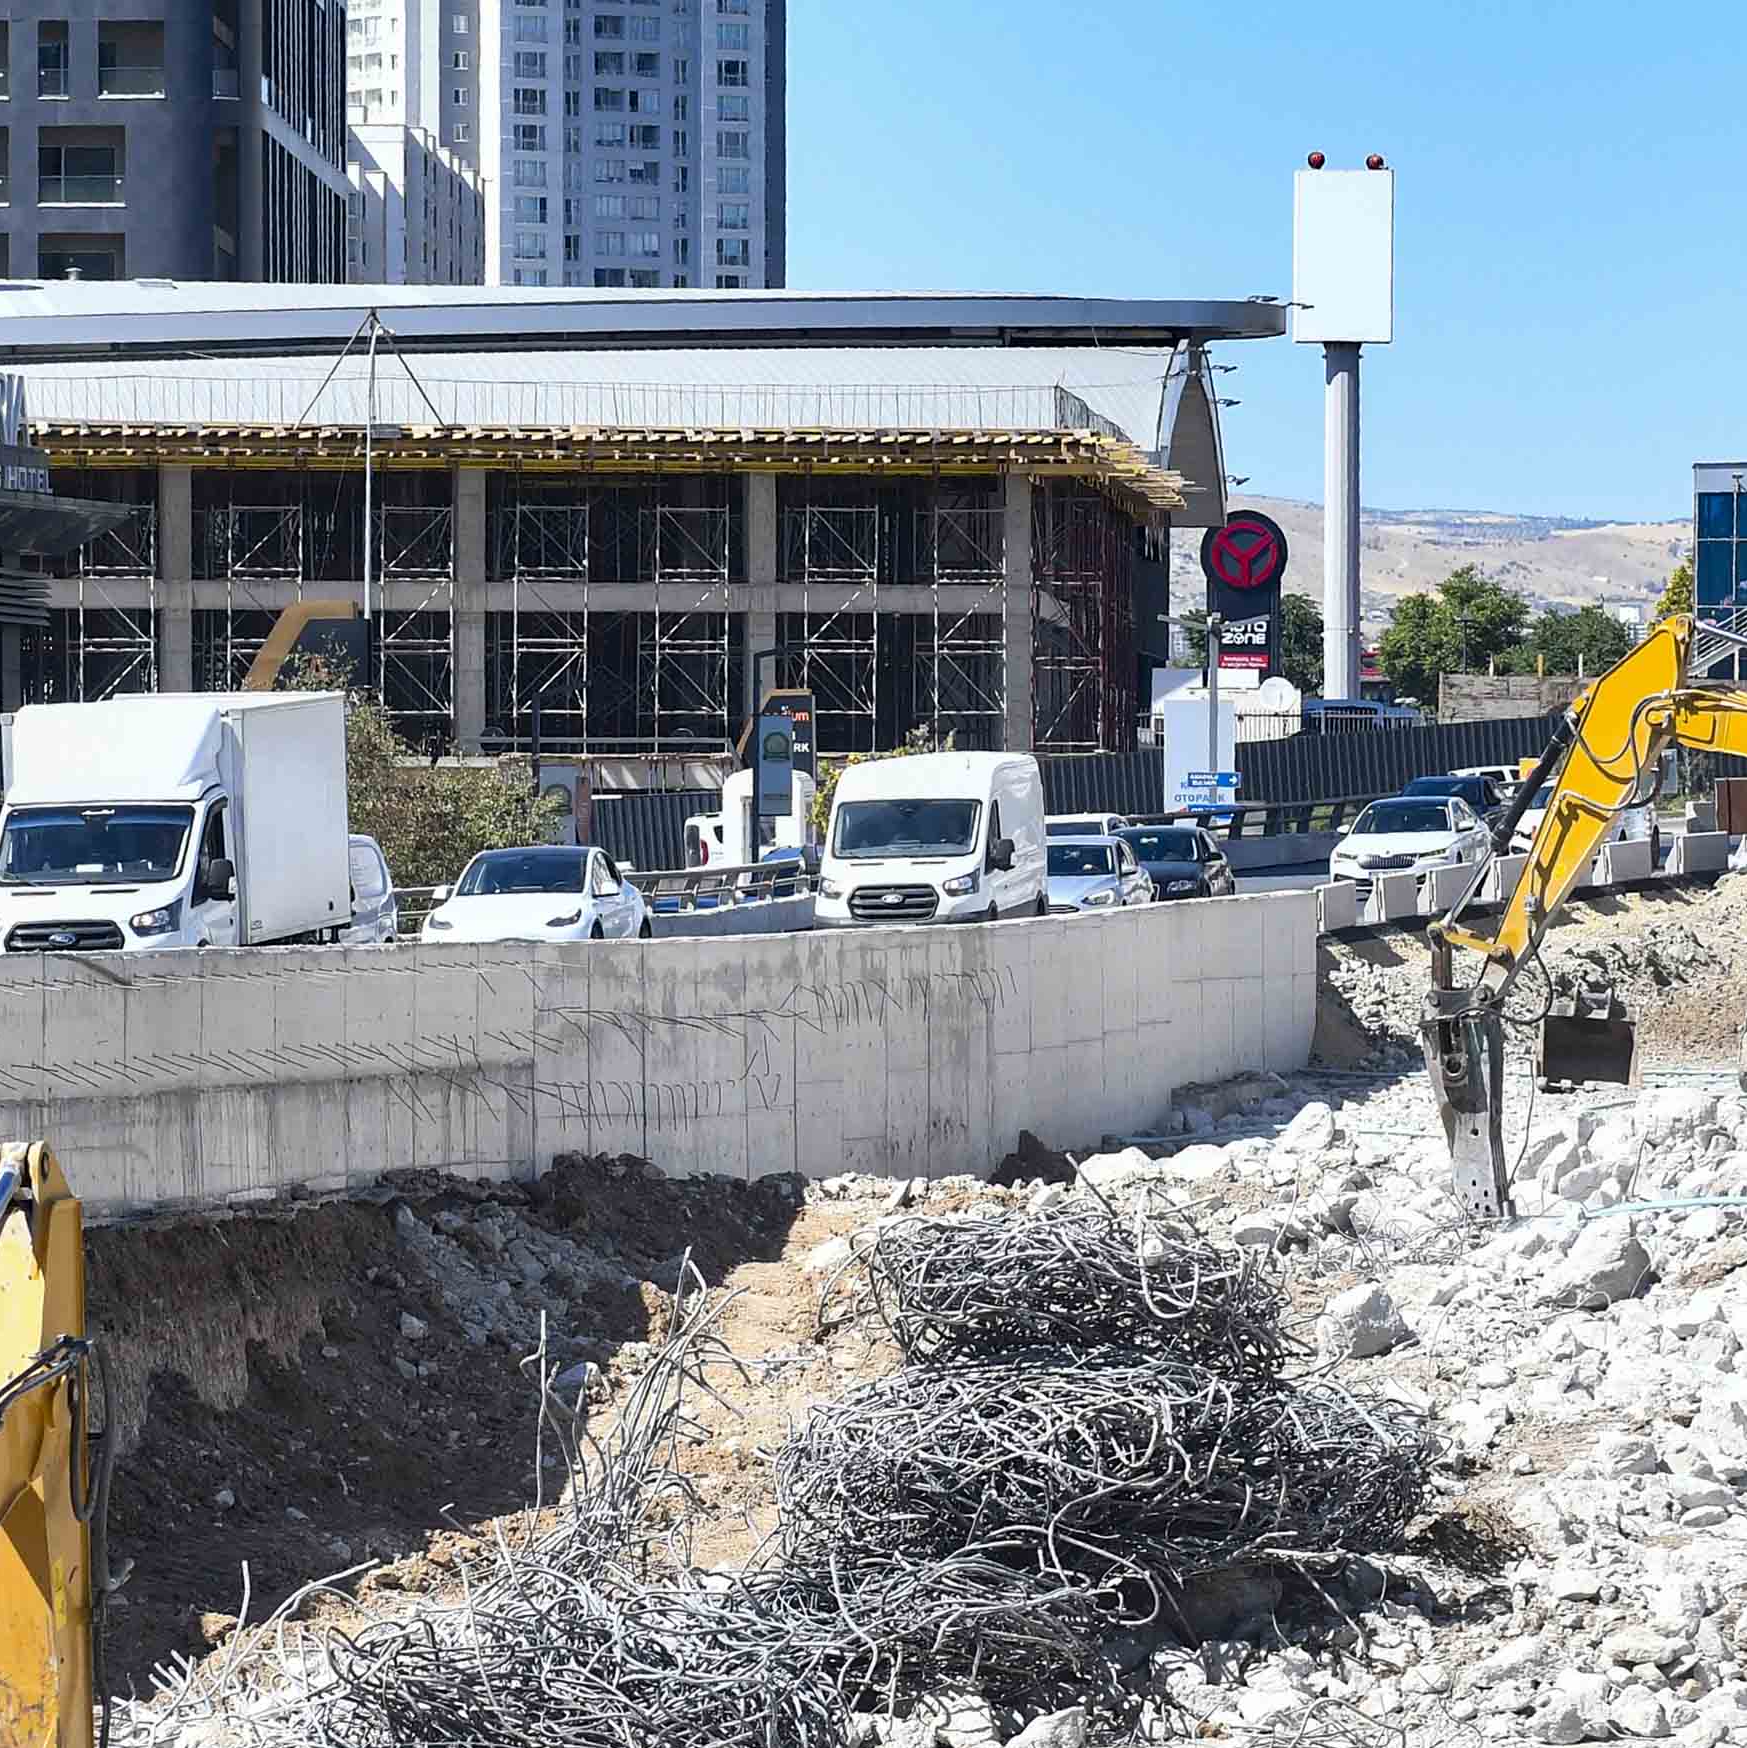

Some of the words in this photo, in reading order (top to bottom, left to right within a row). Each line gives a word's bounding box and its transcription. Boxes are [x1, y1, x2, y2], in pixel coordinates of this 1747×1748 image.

[5, 463, 53, 494] HOTEL
[1221, 632, 1267, 645] ZONE
[1174, 794, 1229, 802] OTOPAK
